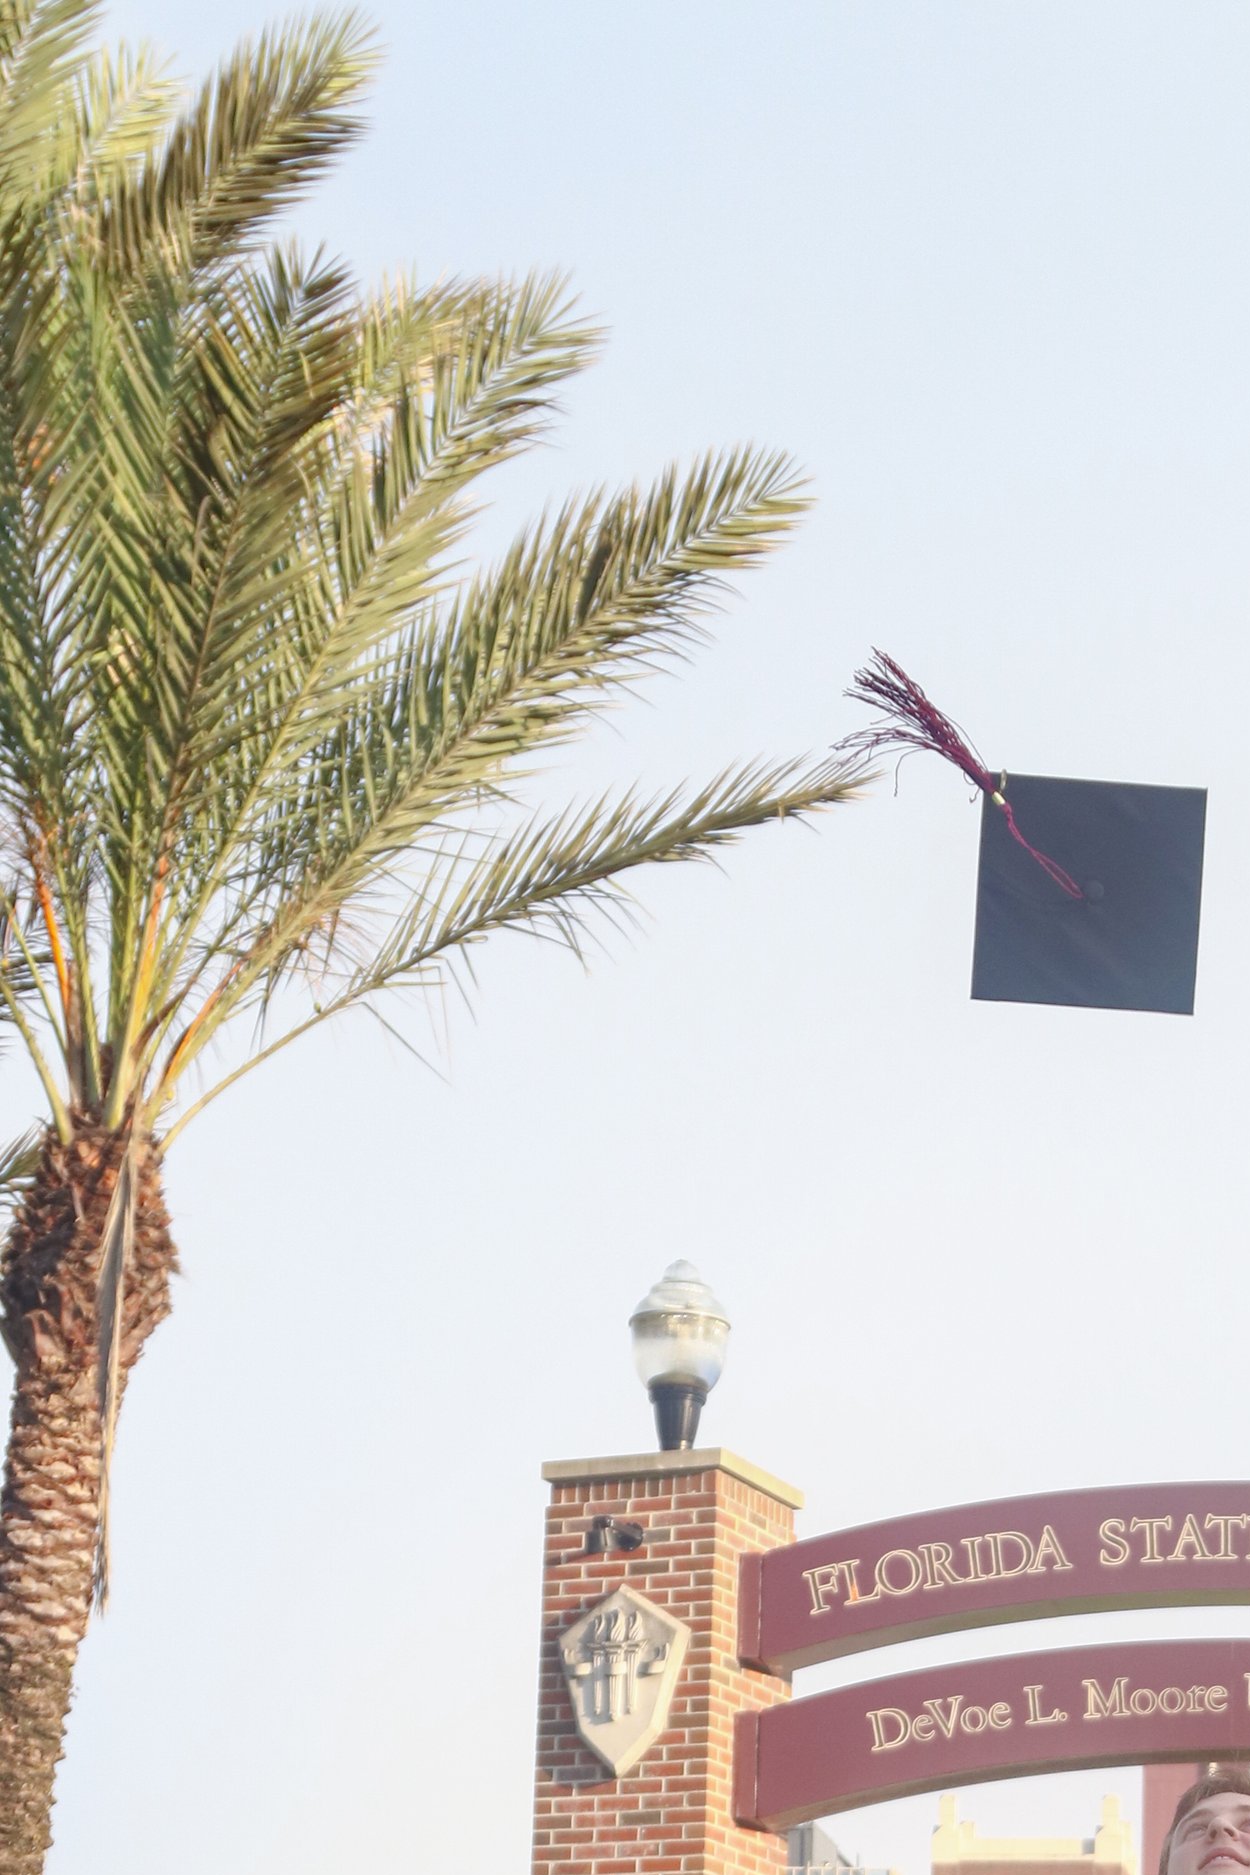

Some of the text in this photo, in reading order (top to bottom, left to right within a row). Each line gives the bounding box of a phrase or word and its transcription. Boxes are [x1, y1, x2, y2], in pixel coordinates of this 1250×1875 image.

[802, 1525, 1072, 1615] FLORIDA
[866, 1695, 1012, 1752] DeVoe
[1024, 1684, 1069, 1725] L.
[1082, 1676, 1228, 1719] Moore
